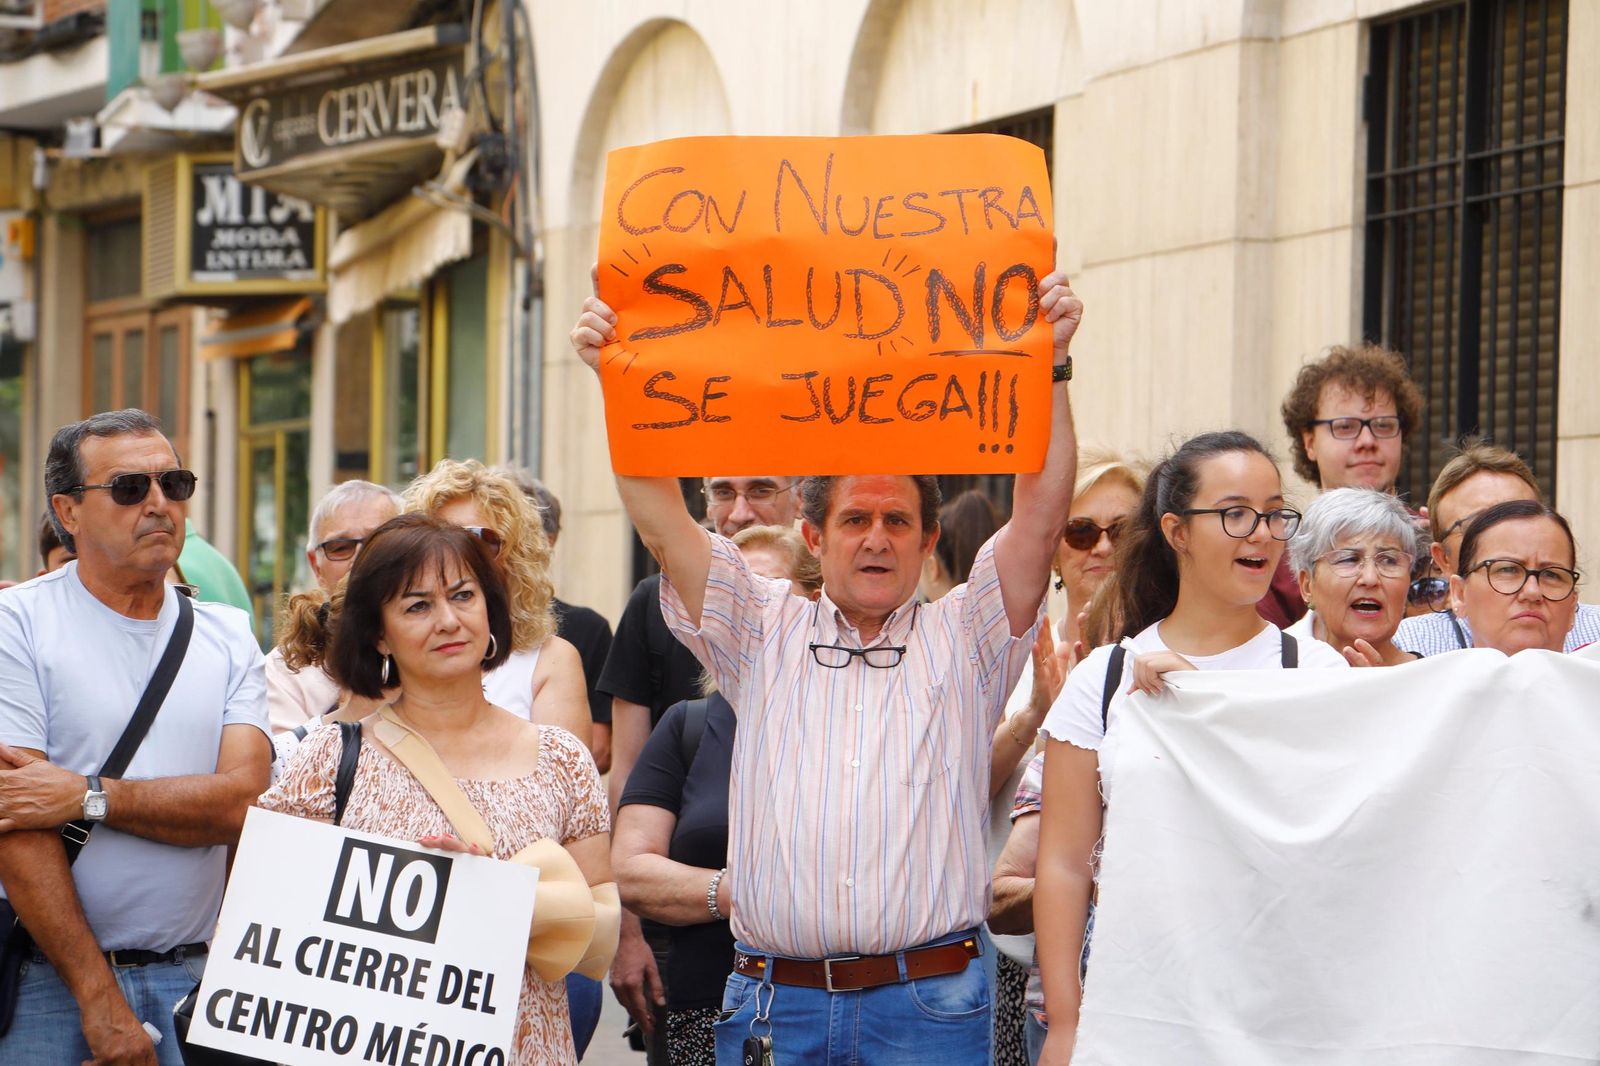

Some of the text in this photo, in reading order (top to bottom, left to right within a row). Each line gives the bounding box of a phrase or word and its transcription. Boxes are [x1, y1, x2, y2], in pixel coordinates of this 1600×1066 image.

[318, 64, 463, 146] CERVERA
[210, 227, 301, 249] MODA
[616, 153, 1046, 240] CON NUESTRA
[205, 249, 308, 271] INTIMA
[629, 261, 1040, 349] SALUD NO
[631, 369, 1019, 455] SE JUEGA!!!
[335, 847, 438, 932] NO
[233, 922, 496, 1015] AL CIERRE DEL
[205, 988, 358, 1055] CENTRO
